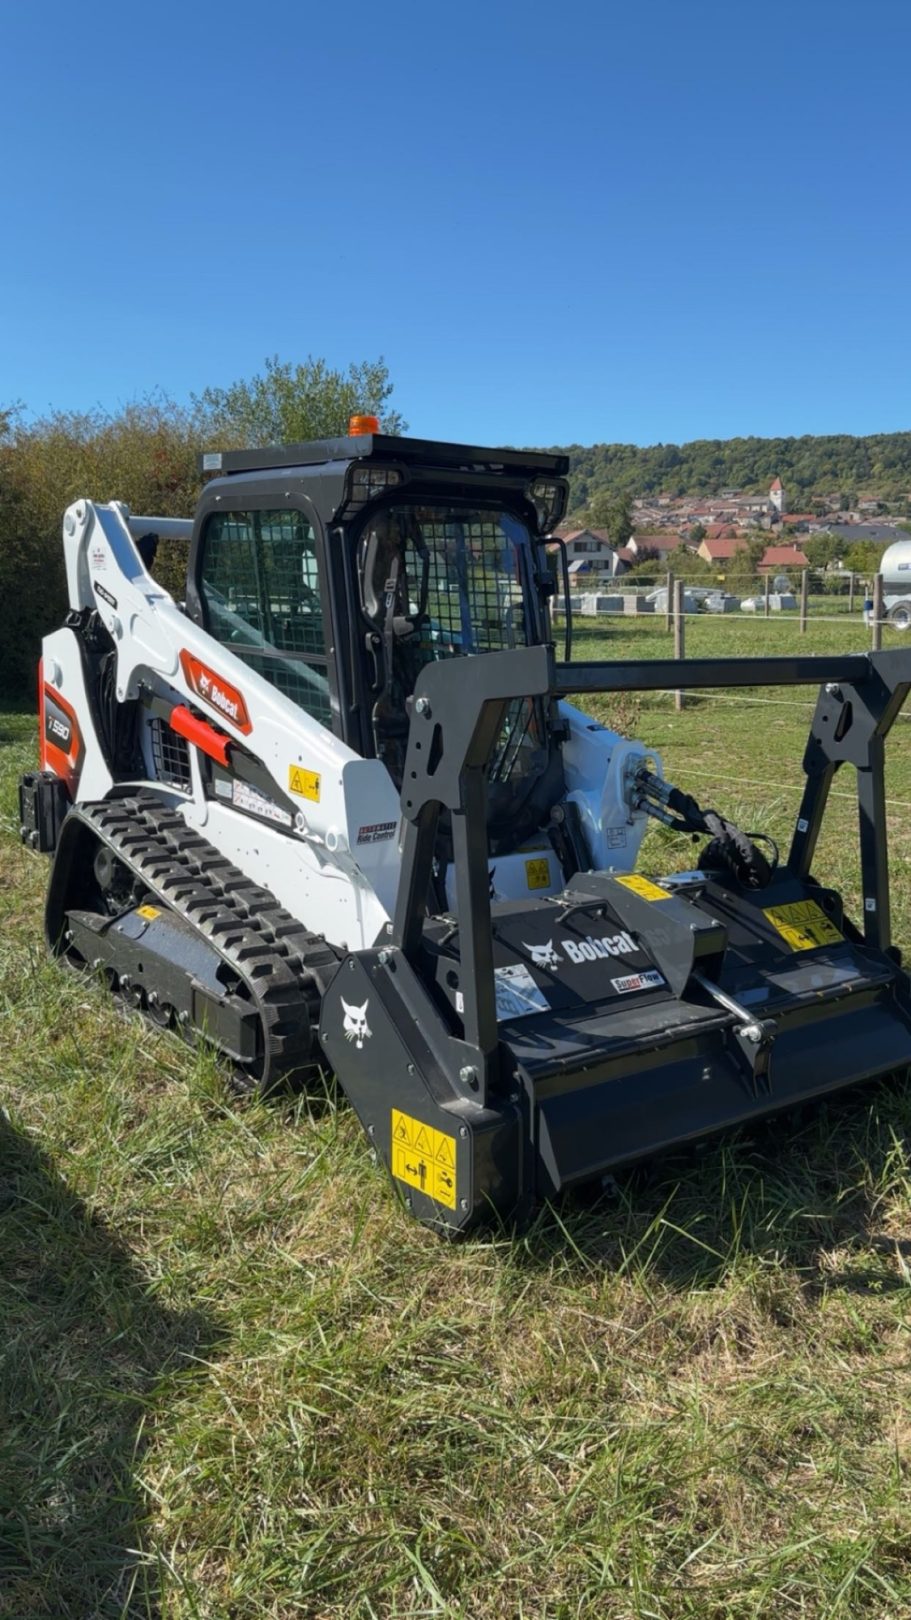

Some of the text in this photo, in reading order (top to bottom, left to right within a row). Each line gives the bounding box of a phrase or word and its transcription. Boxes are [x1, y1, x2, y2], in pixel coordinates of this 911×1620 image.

[211, 685, 238, 719] Bobcat
[561, 931, 639, 964] Bobcat
[614, 971, 661, 990] SuperFlow
